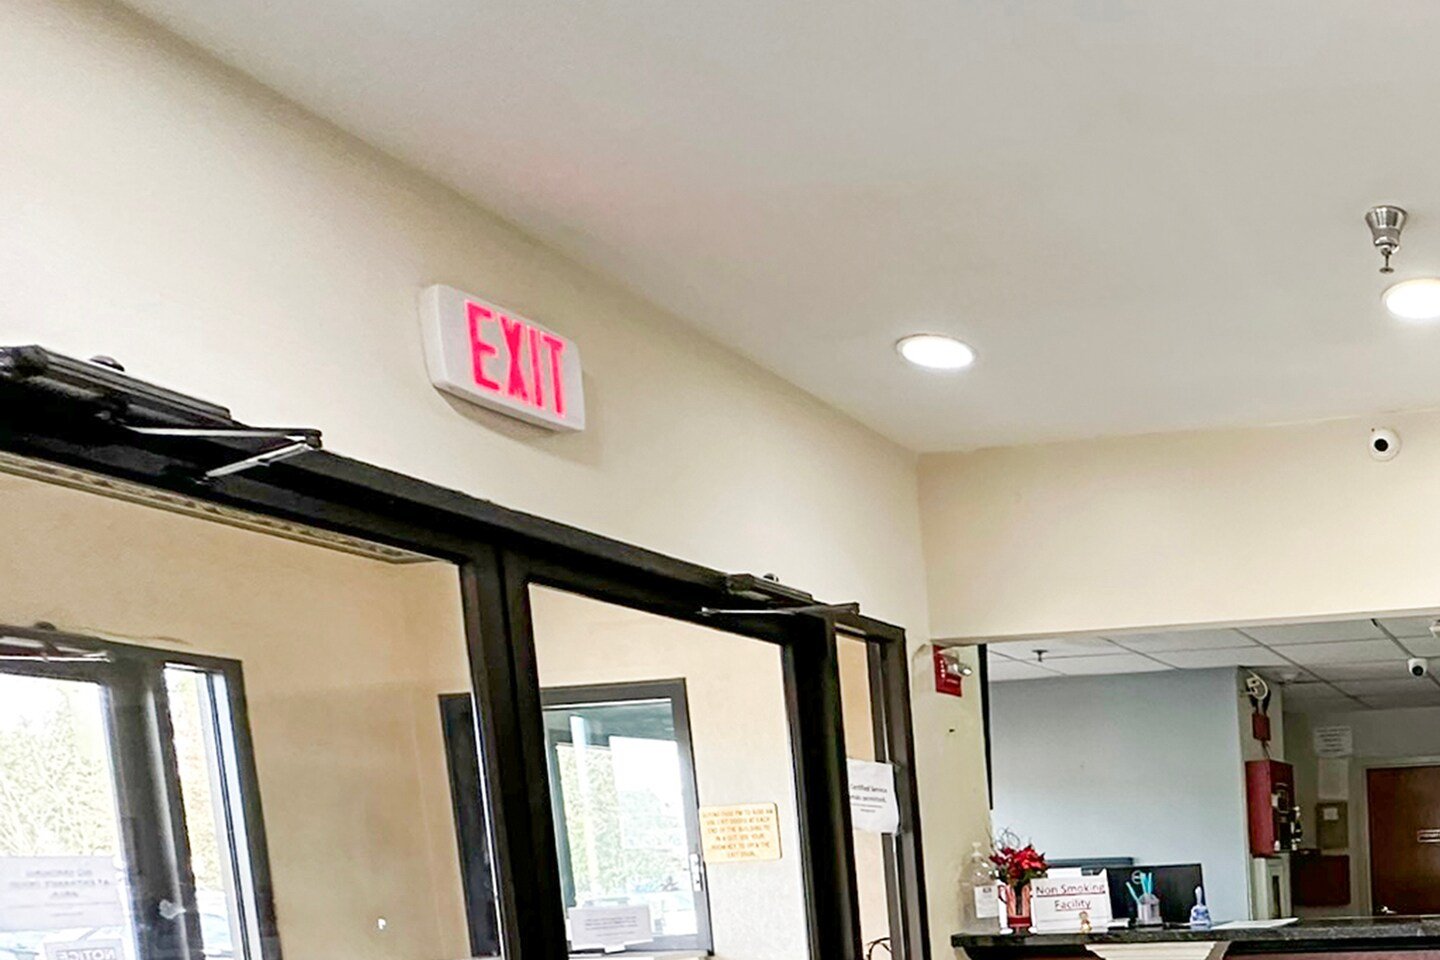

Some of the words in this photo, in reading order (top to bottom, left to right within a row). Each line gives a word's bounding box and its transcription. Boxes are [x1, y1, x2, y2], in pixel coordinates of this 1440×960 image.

[464, 300, 565, 418] EXIT
[1035, 885, 1059, 895] Non
[1060, 883, 1106, 895] Smoking
[1054, 899, 1092, 910] Facility
